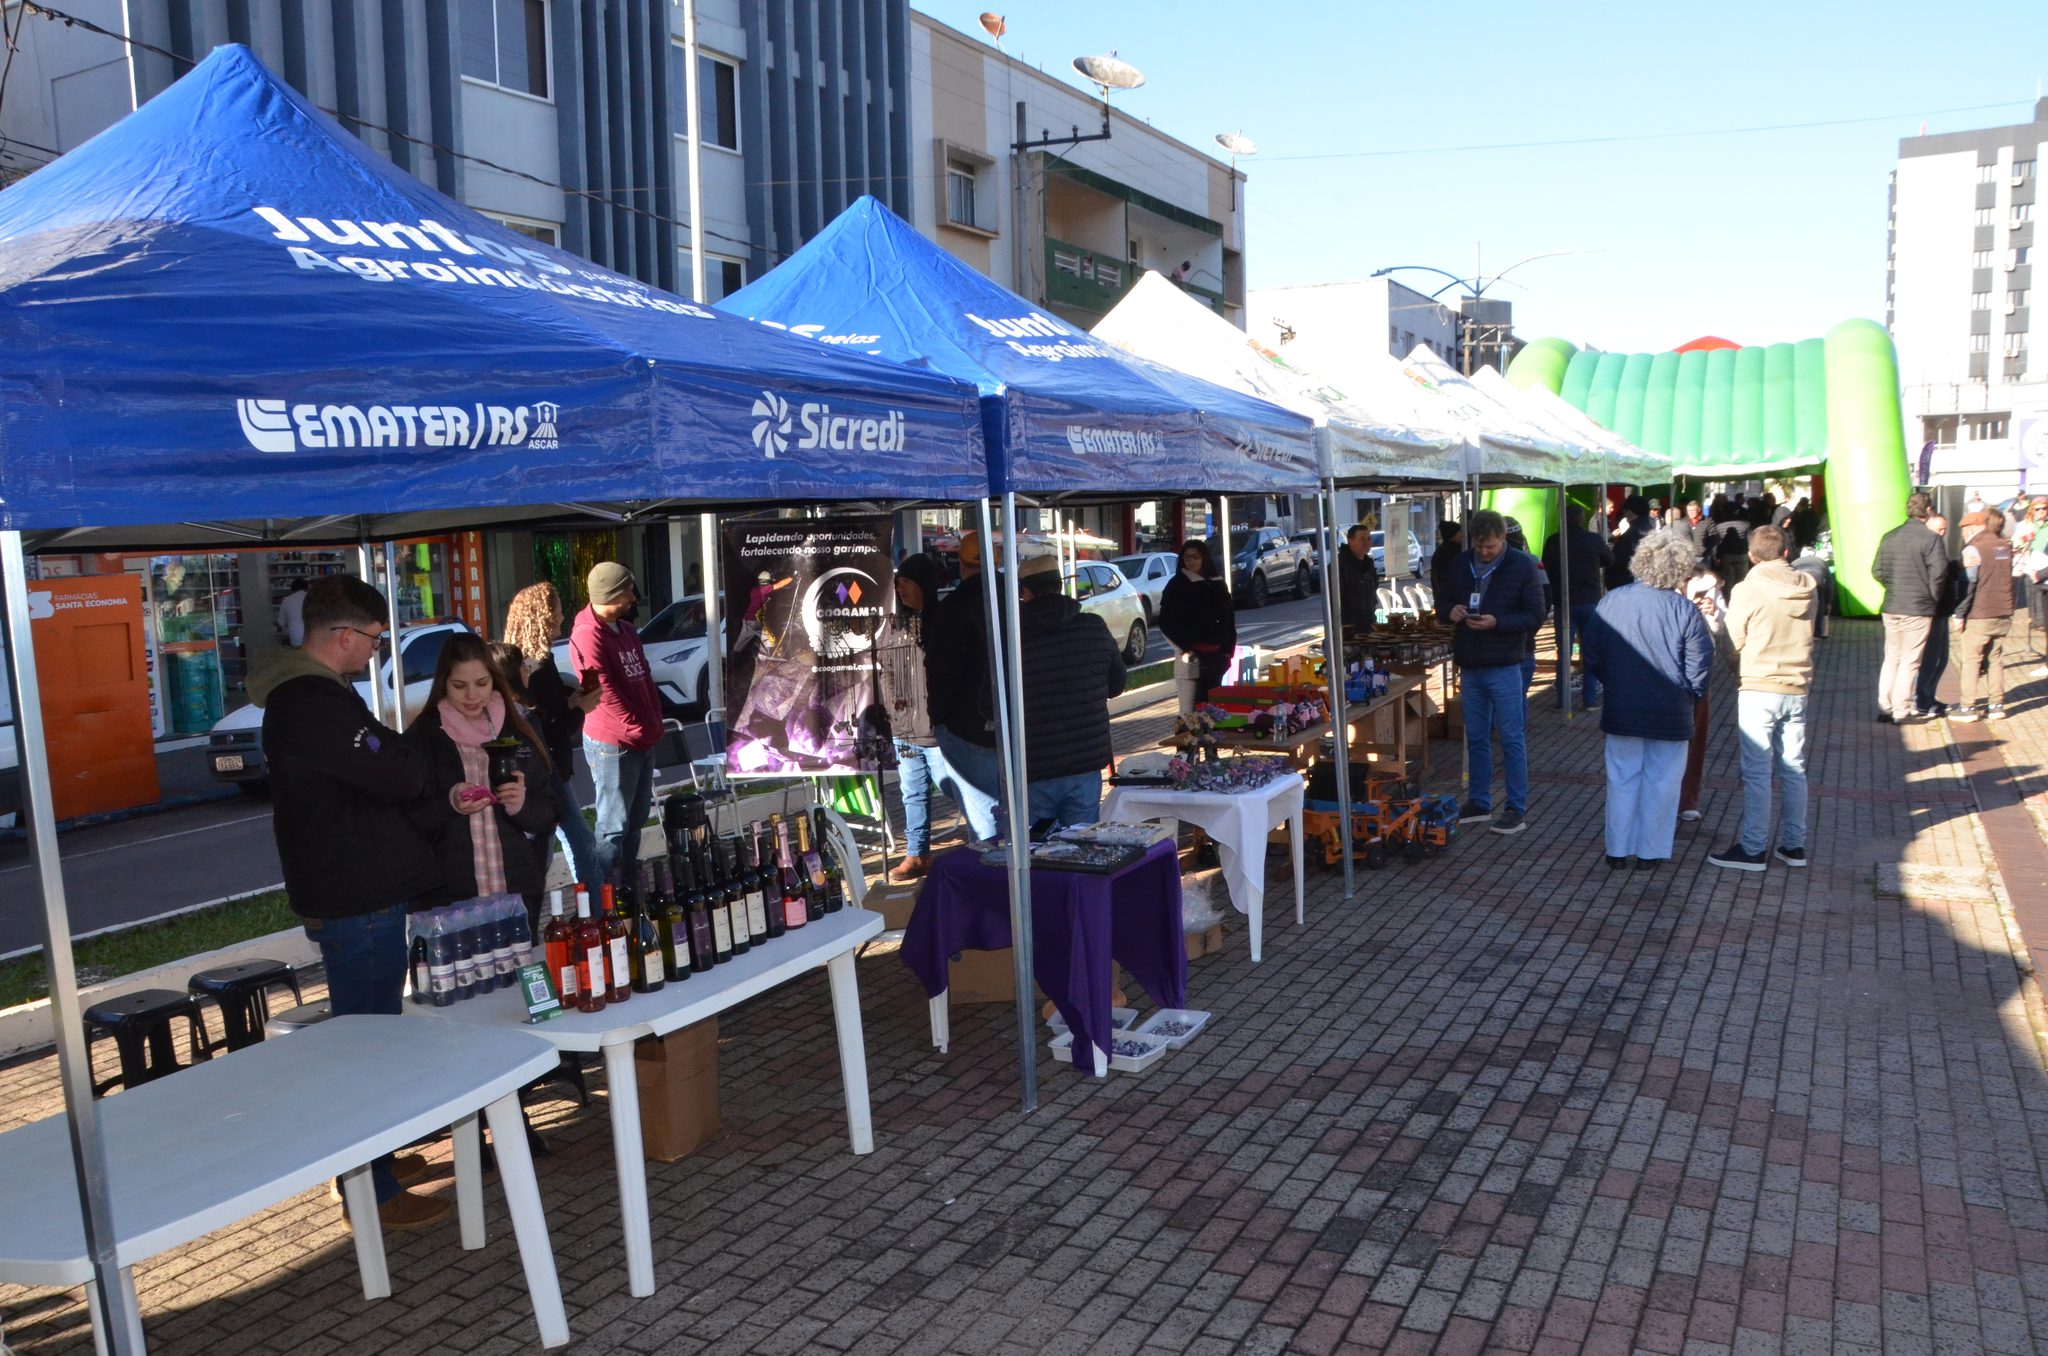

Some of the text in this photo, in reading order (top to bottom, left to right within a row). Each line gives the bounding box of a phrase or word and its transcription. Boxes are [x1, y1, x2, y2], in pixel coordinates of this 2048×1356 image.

[252, 206, 572, 275] Juntos
[964, 312, 1071, 338] Junt
[292, 403, 530, 450] EMATER/RS
[798, 402, 905, 452] Sicredi
[528, 439, 559, 449] ASCAR
[745, 531, 877, 545] Lapidando oportunidades,
[740, 544, 881, 557] fortalecendo nosso garimpo.
[55, 592, 97, 601] FARMÁCIAS
[55, 598, 128, 610] SANTA ECONOMIA
